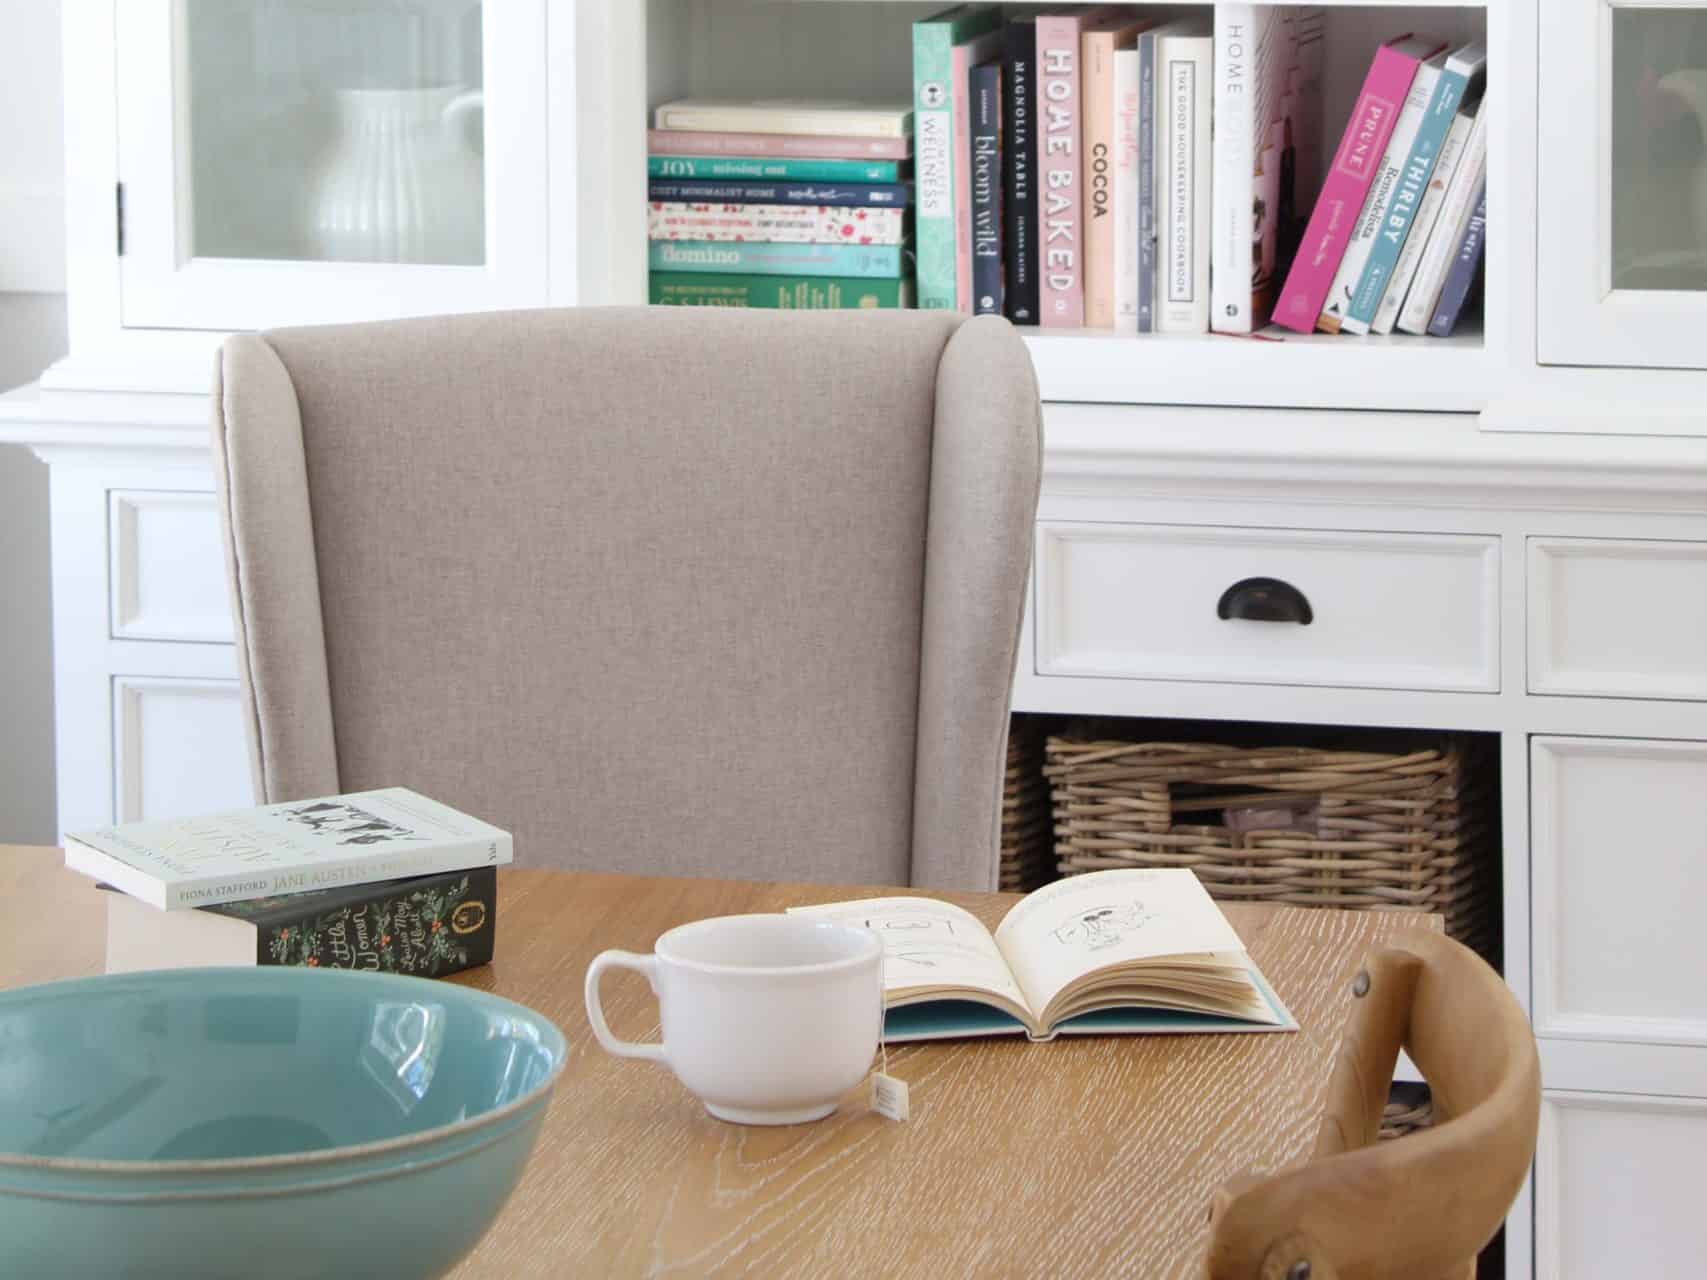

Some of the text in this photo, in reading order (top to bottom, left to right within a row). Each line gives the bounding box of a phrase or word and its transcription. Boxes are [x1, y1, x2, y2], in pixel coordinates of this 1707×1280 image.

[1227, 24, 1244, 94] HOME
[923, 119, 936, 210] WELLNESS
[1014, 61, 1027, 200] MAGNOLIA TABLE
[1349, 105, 1385, 167] PRUNE
[658, 161, 697, 176] JOY
[975, 135, 997, 204] bloom
[1044, 48, 1074, 292] HOME BAKED
[1093, 142, 1109, 219] COCOA
[1176, 70, 1188, 294] THE GOOD HOUSEKEEPING COOKBOOK
[1361, 167, 1400, 240] Remodelista
[1383, 155, 1431, 245] THIRLBY
[660, 243, 741, 264] domino
[976, 210, 997, 257] wild
[179, 886, 214, 902] FIONA
[215, 879, 267, 898] STAFFORD
[272, 872, 305, 890] JANE
